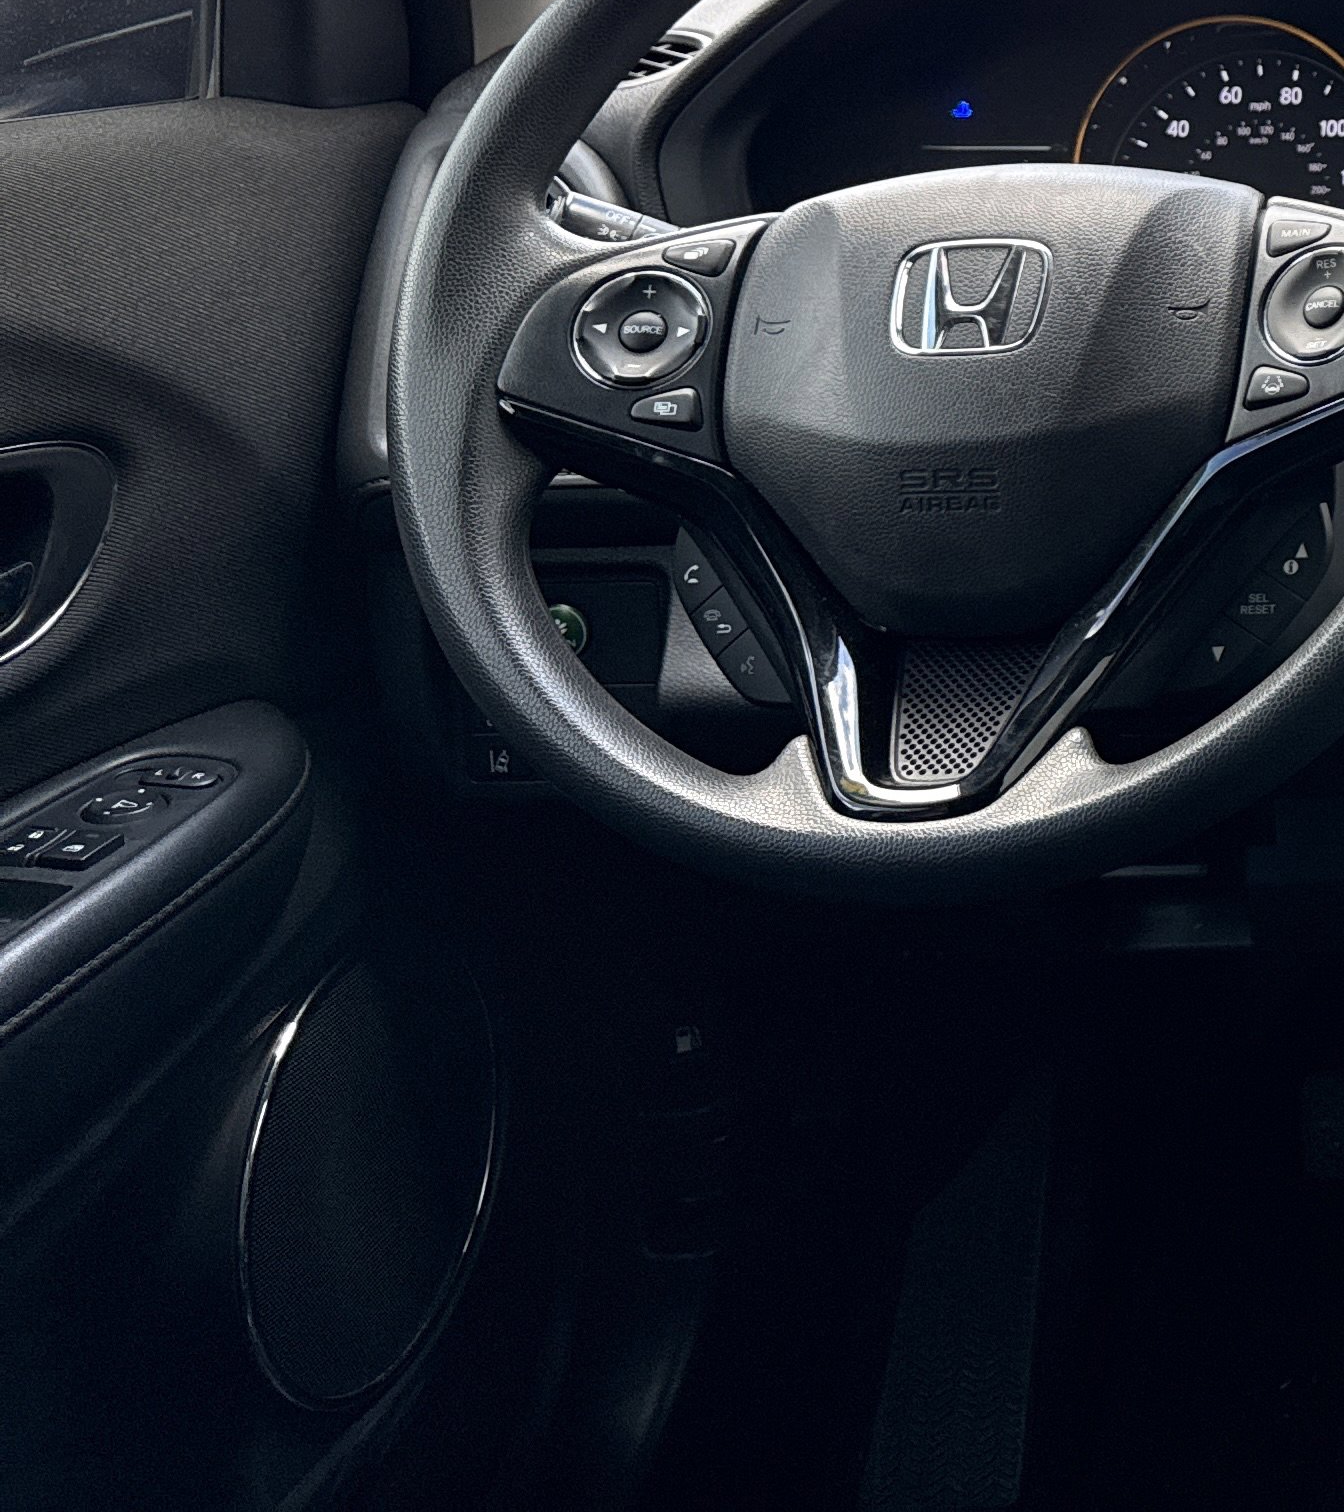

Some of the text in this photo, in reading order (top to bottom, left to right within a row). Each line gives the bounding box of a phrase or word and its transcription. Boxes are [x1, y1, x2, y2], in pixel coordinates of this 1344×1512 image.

[1218, 85, 1243, 105] 60
[1278, 85, 1303, 105] 80
[1248, 100, 1272, 113] mph
[1164, 118, 1191, 139] 40
[1280, 228, 1312, 239] MAIN
[1315, 257, 1337, 270] RES
[1304, 299, 1340, 312] CANCEL
[623, 324, 664, 336] SOURCE
[899, 467, 1000, 490] SRS
[1248, 593, 1270, 604] SEL
[1240, 604, 1276, 615] RESET
